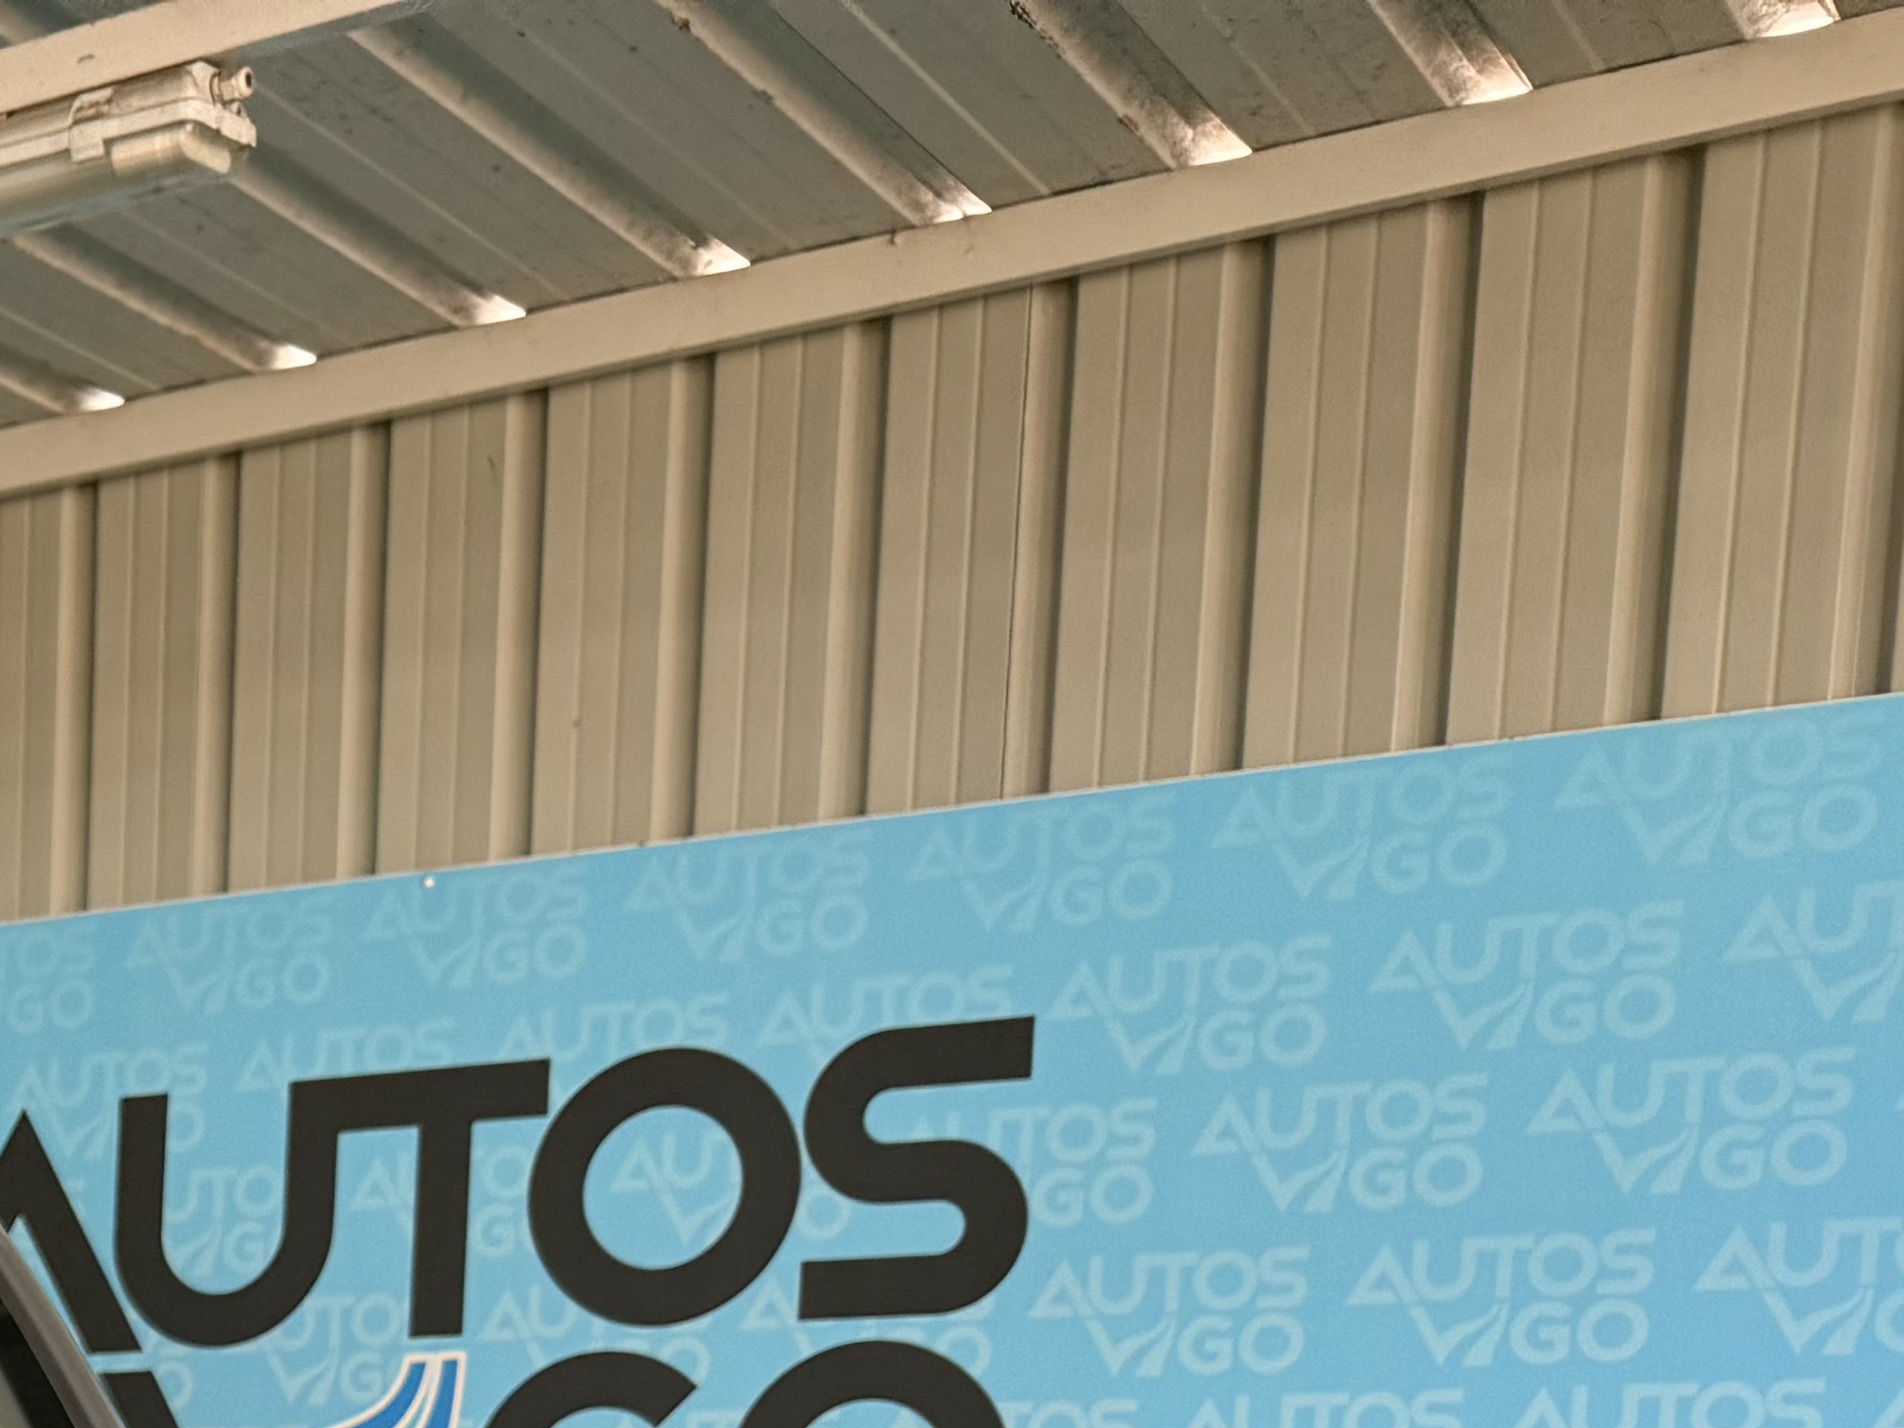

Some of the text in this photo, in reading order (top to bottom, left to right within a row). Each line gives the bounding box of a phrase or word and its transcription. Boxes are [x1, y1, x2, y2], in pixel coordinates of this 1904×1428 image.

[1211, 753, 1514, 848] AUTOS
[1552, 713, 1885, 812] AUTOS
[905, 792, 1178, 884] AUTOS
[1271, 822, 1508, 899] VIGO
[1617, 783, 1880, 866] VIGO
[363, 862, 589, 942] AUTOS
[622, 828, 873, 912] AUTOS
[957, 858, 1174, 933] VIGO
[125, 894, 335, 970] AUTOS
[409, 925, 589, 991] VIGO
[674, 892, 869, 963] VIGO
[1367, 899, 1685, 993] AUTOS
[166, 951, 332, 1015] VIGO
[756, 965, 1015, 1048] AUTOS
[1045, 934, 1332, 1022] AUTOS
[1432, 973, 1678, 1051] VIGO
[234, 1018, 454, 1092] AUTOS
[1104, 1002, 1328, 1074] VIGO
[1191, 1072, 1489, 1156] AUTOS
[1525, 1046, 1857, 1135] AUTOS
[1250, 1142, 1484, 1213] VIGO
[1592, 1119, 1849, 1195] VIGO
[1026, 1244, 1311, 1319] AUTOS
[1344, 1226, 1657, 1308] AUTOS
[1085, 1312, 1306, 1378] VIGO
[1408, 1298, 1651, 1368] VIGO
